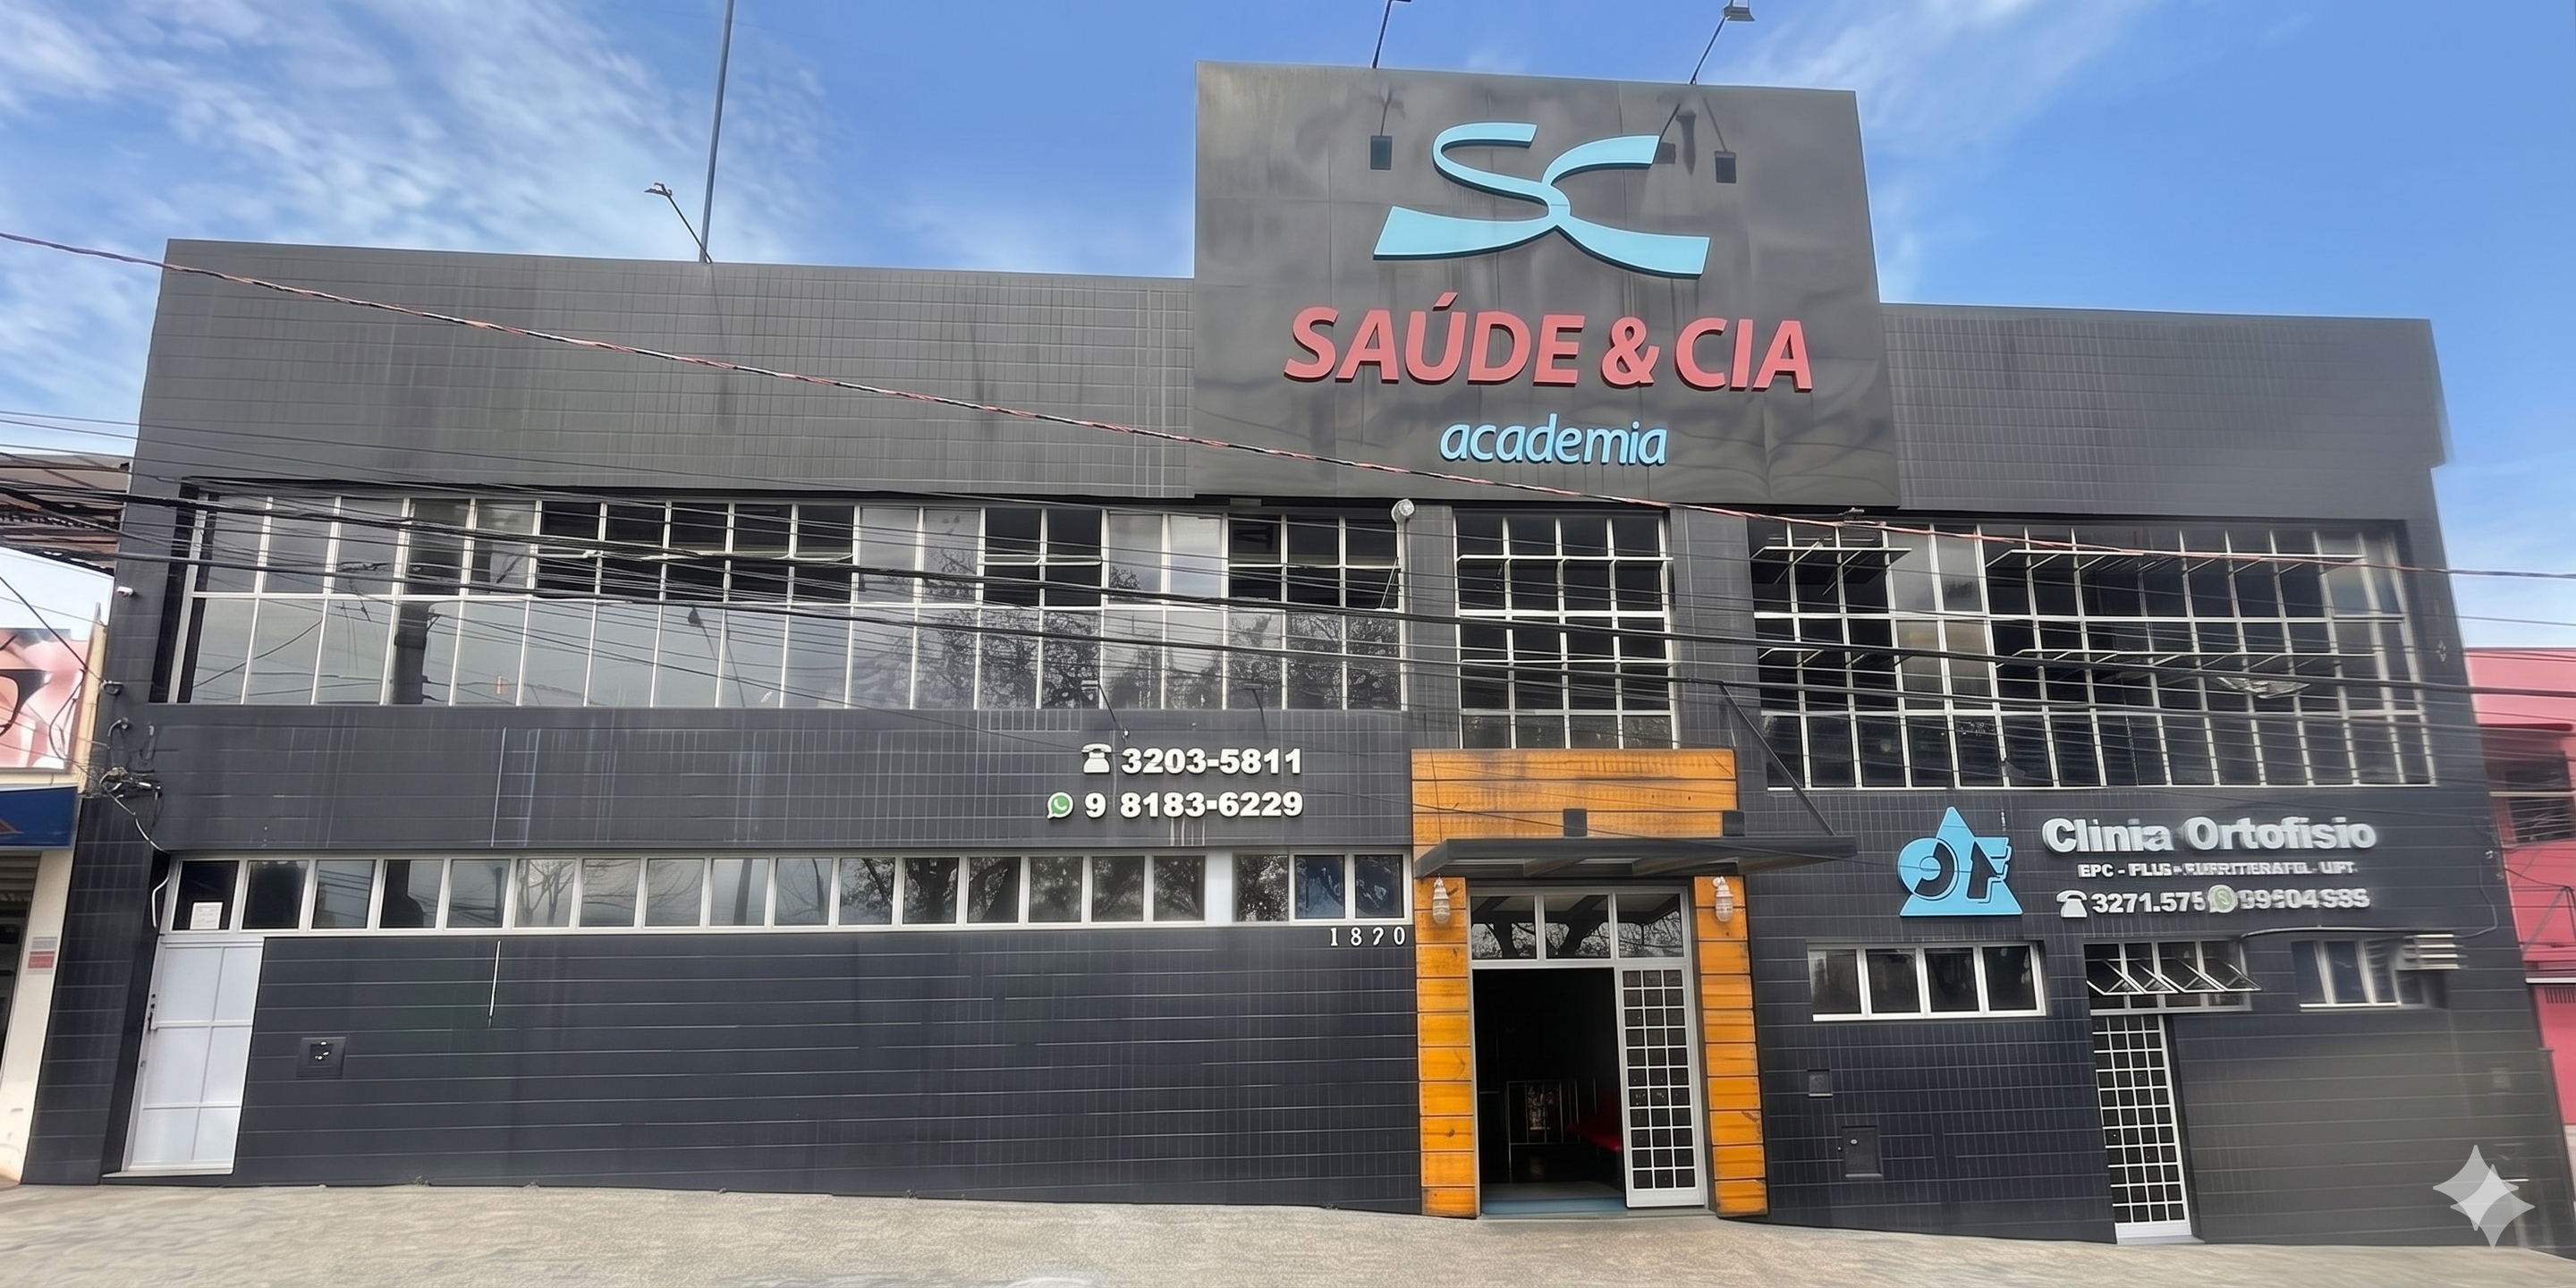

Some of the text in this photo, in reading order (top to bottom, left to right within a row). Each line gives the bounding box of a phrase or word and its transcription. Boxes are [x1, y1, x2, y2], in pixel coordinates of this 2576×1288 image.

[1284, 292, 1813, 392] SAÚDE & CIA
[1440, 413, 1669, 467] academia
[1120, 747, 1302, 775] 3203-5811
[1084, 791, 1304, 819] 9 8183-6229
[2182, 817, 2377, 850] Ortofisio
